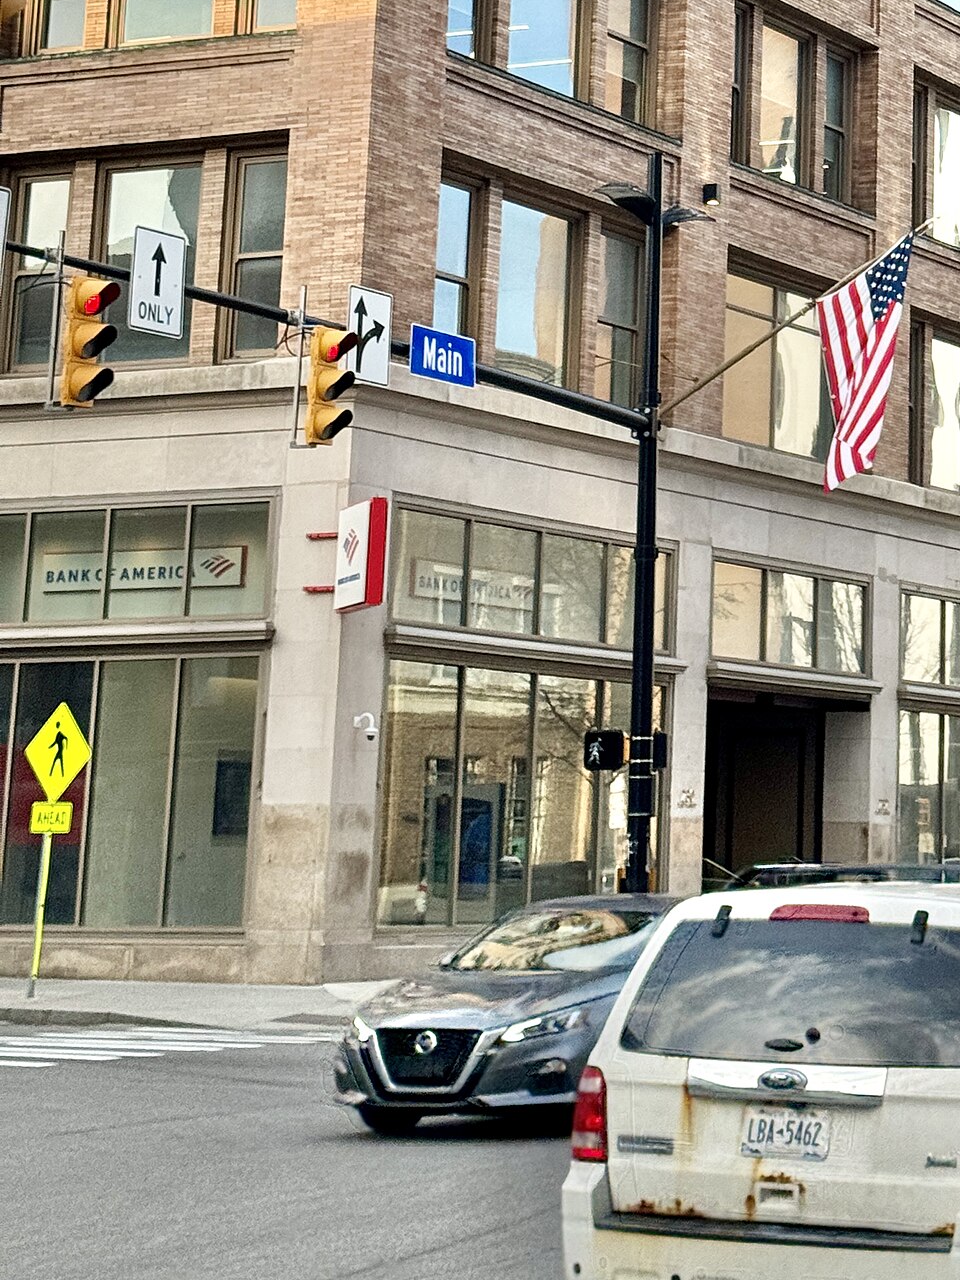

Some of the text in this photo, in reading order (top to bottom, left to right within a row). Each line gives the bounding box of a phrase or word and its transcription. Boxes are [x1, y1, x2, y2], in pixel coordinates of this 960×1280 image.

[138, 301, 174, 325] ONLY
[422, 335, 463, 377] Main
[46, 568, 90, 584] BANK
[418, 575, 448, 592] BANK
[37, 811, 67, 825] AHEAD
